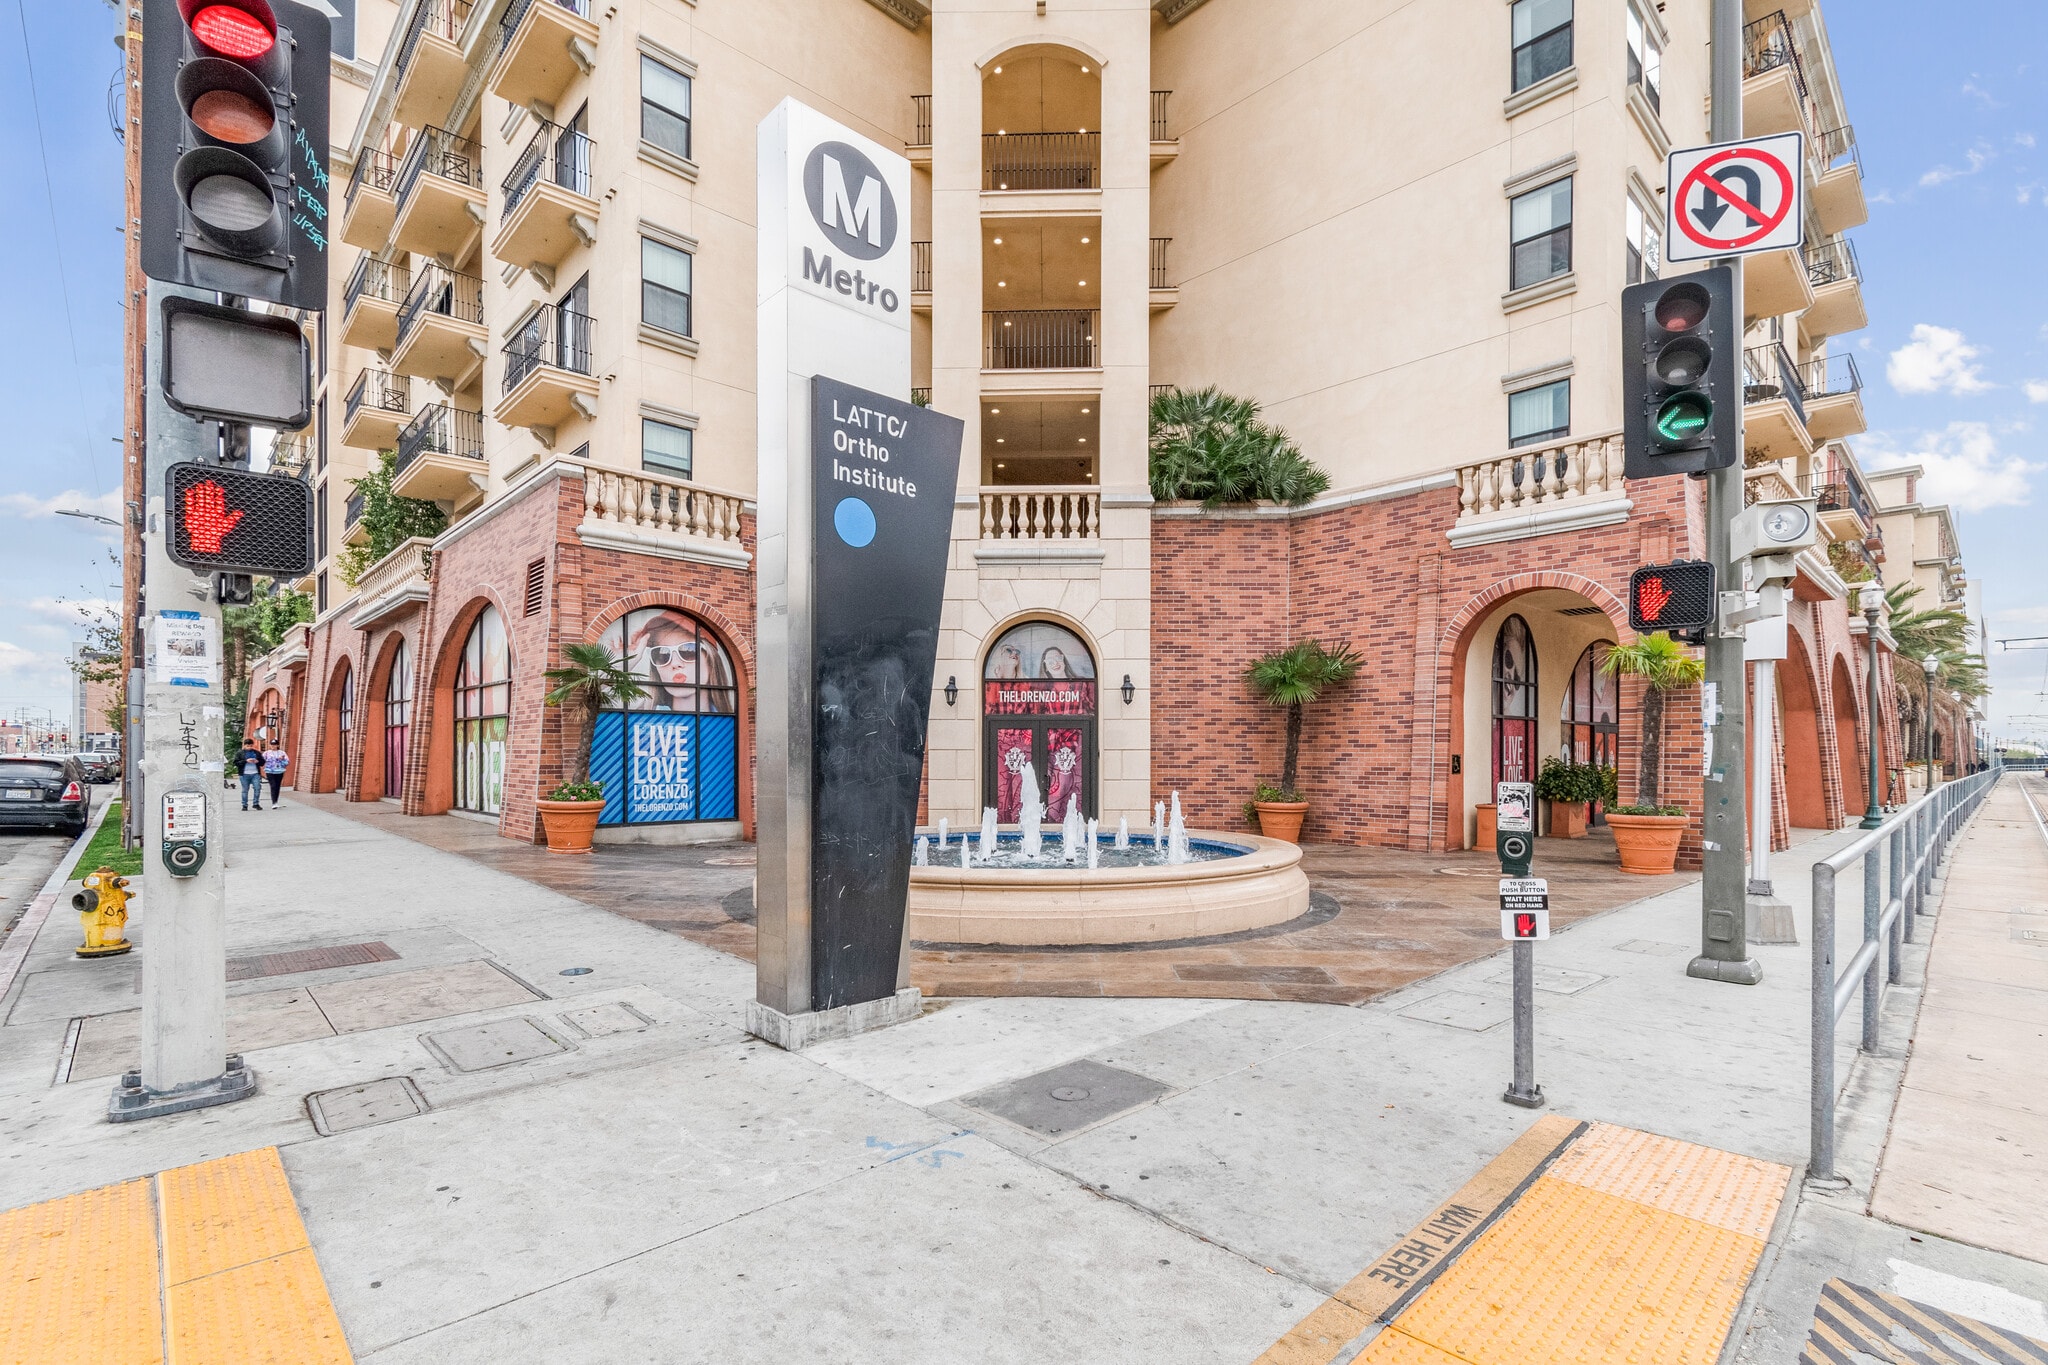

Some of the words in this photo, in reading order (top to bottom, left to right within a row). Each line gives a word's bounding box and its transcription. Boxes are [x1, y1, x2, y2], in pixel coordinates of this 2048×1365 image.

[823, 153, 881, 248] M
[803, 246, 899, 313] Metro
[833, 399, 908, 439] LATTC/
[833, 429, 890, 463] Ortho
[833, 458, 917, 498] Institute
[998, 690, 1080, 703] THELORENZO.COM
[633, 724, 689, 757] LIVE
[1503, 735, 1523, 766] LIVE
[633, 756, 689, 784] LOVE
[633, 783, 689, 801] LORENZO
[634, 803, 689, 813] THELORENZO.COM
[1421, 1203, 1483, 1245] WAIT
[1367, 1238, 1442, 1290] HERE
